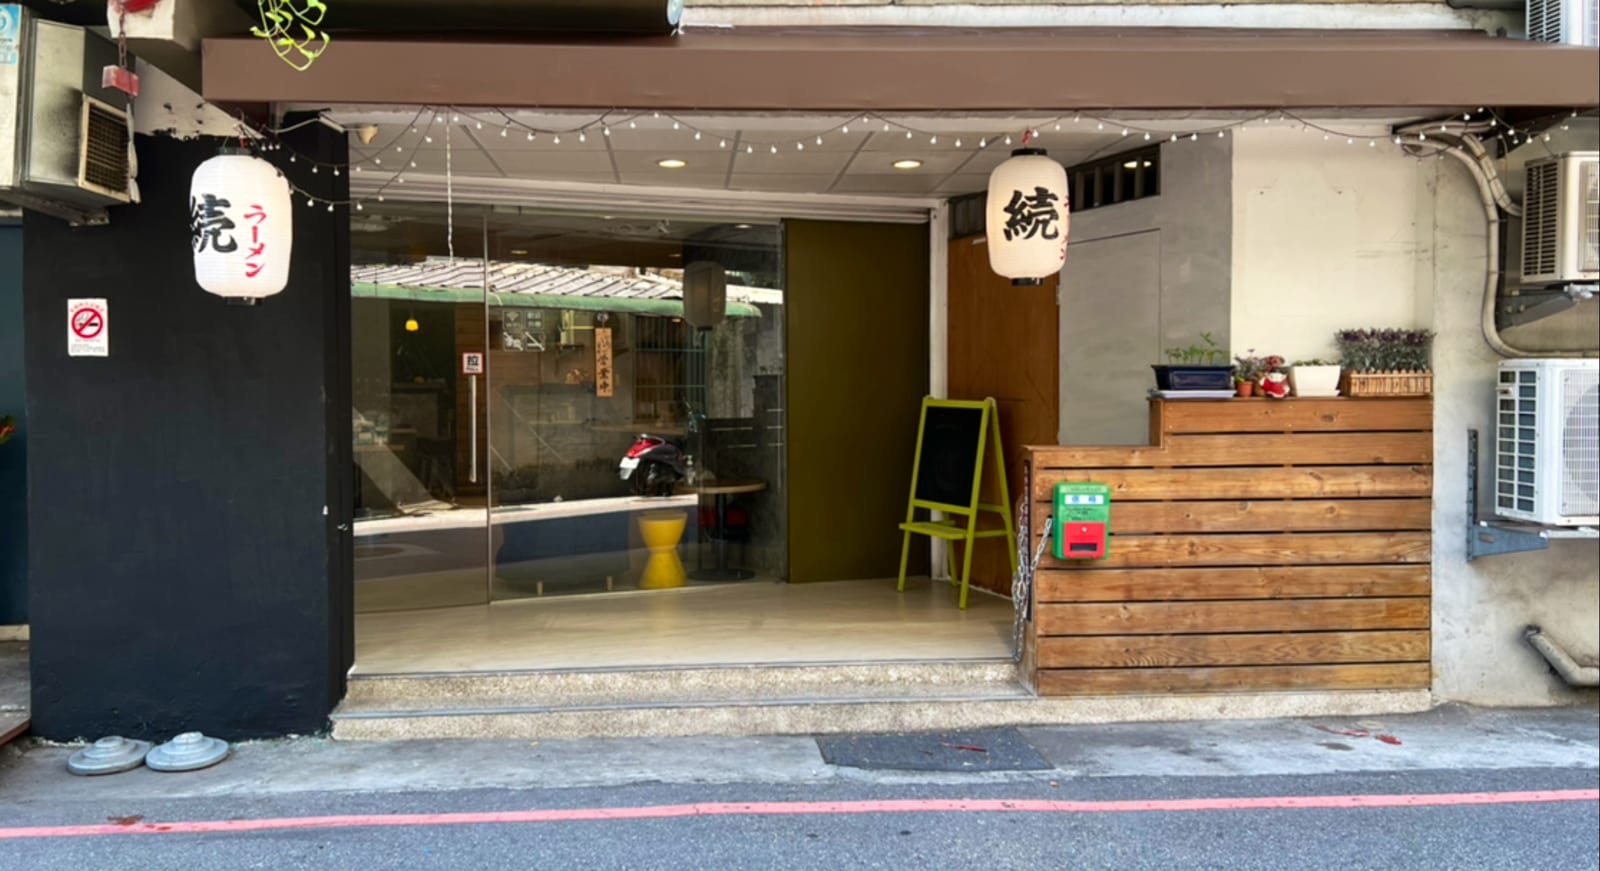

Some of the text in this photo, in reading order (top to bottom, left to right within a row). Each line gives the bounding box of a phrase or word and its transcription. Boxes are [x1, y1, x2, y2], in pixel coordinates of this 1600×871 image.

[243, 204, 267, 278] ラーメン
[1003, 186, 1059, 241] 続
